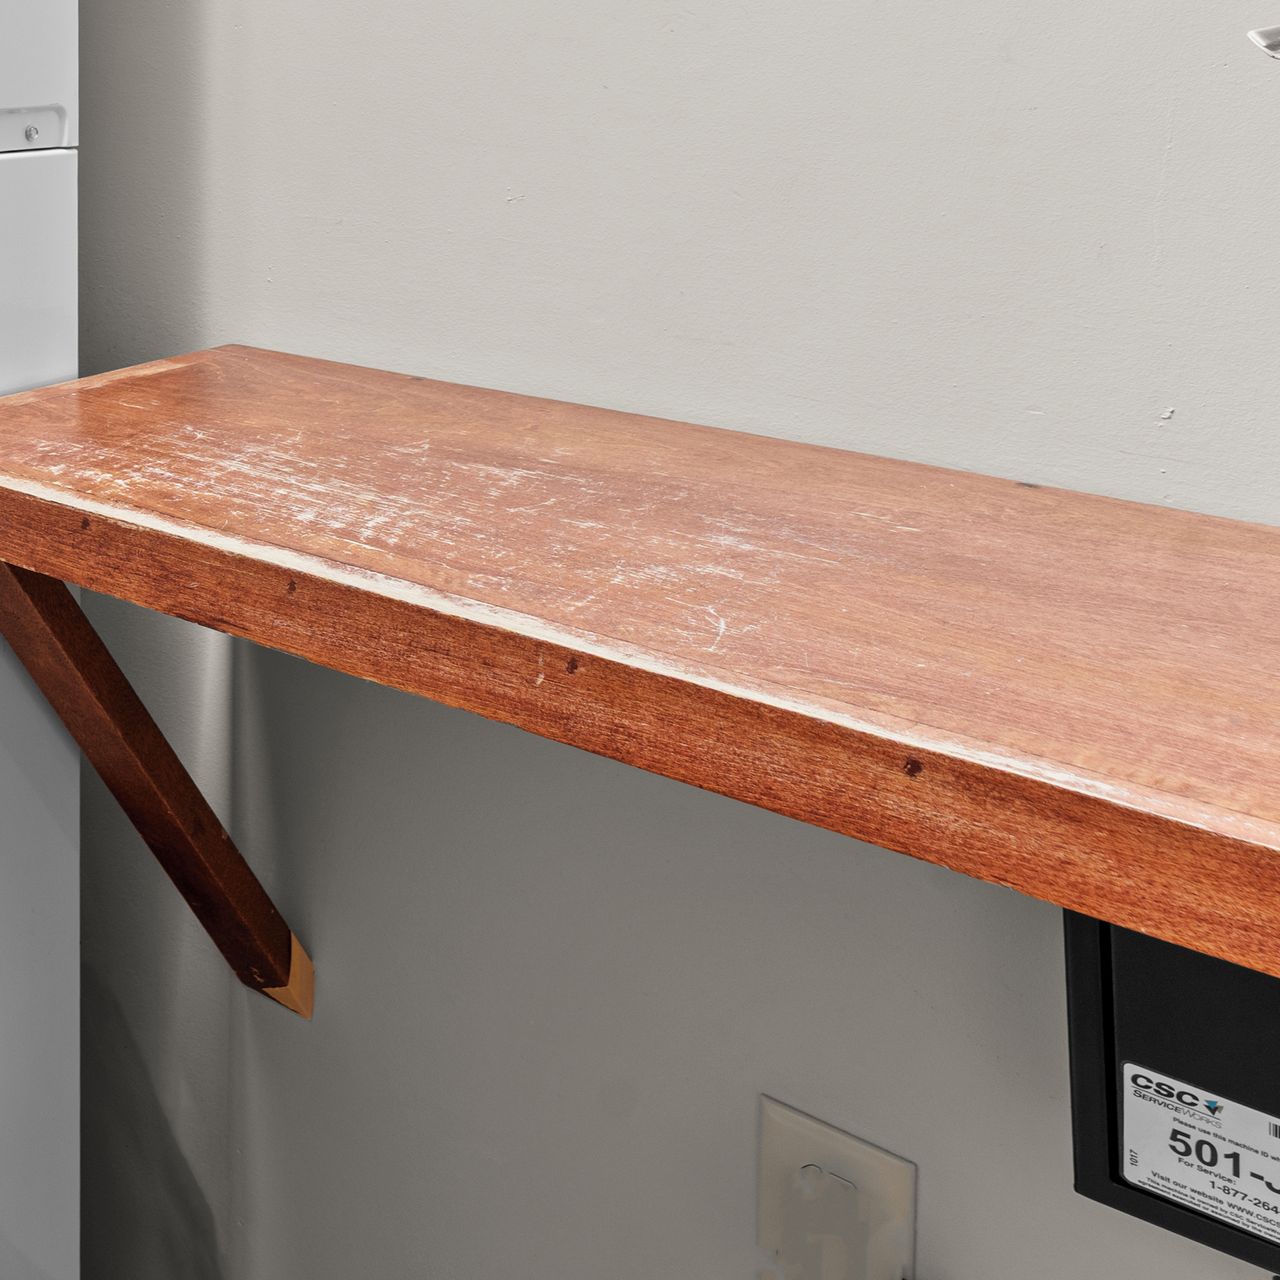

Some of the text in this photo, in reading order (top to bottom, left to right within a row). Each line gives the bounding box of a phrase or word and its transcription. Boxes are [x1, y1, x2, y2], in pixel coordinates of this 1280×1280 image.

[1131, 1074, 1199, 1107] CSC
[1178, 1157, 1237, 1185] For Service:
